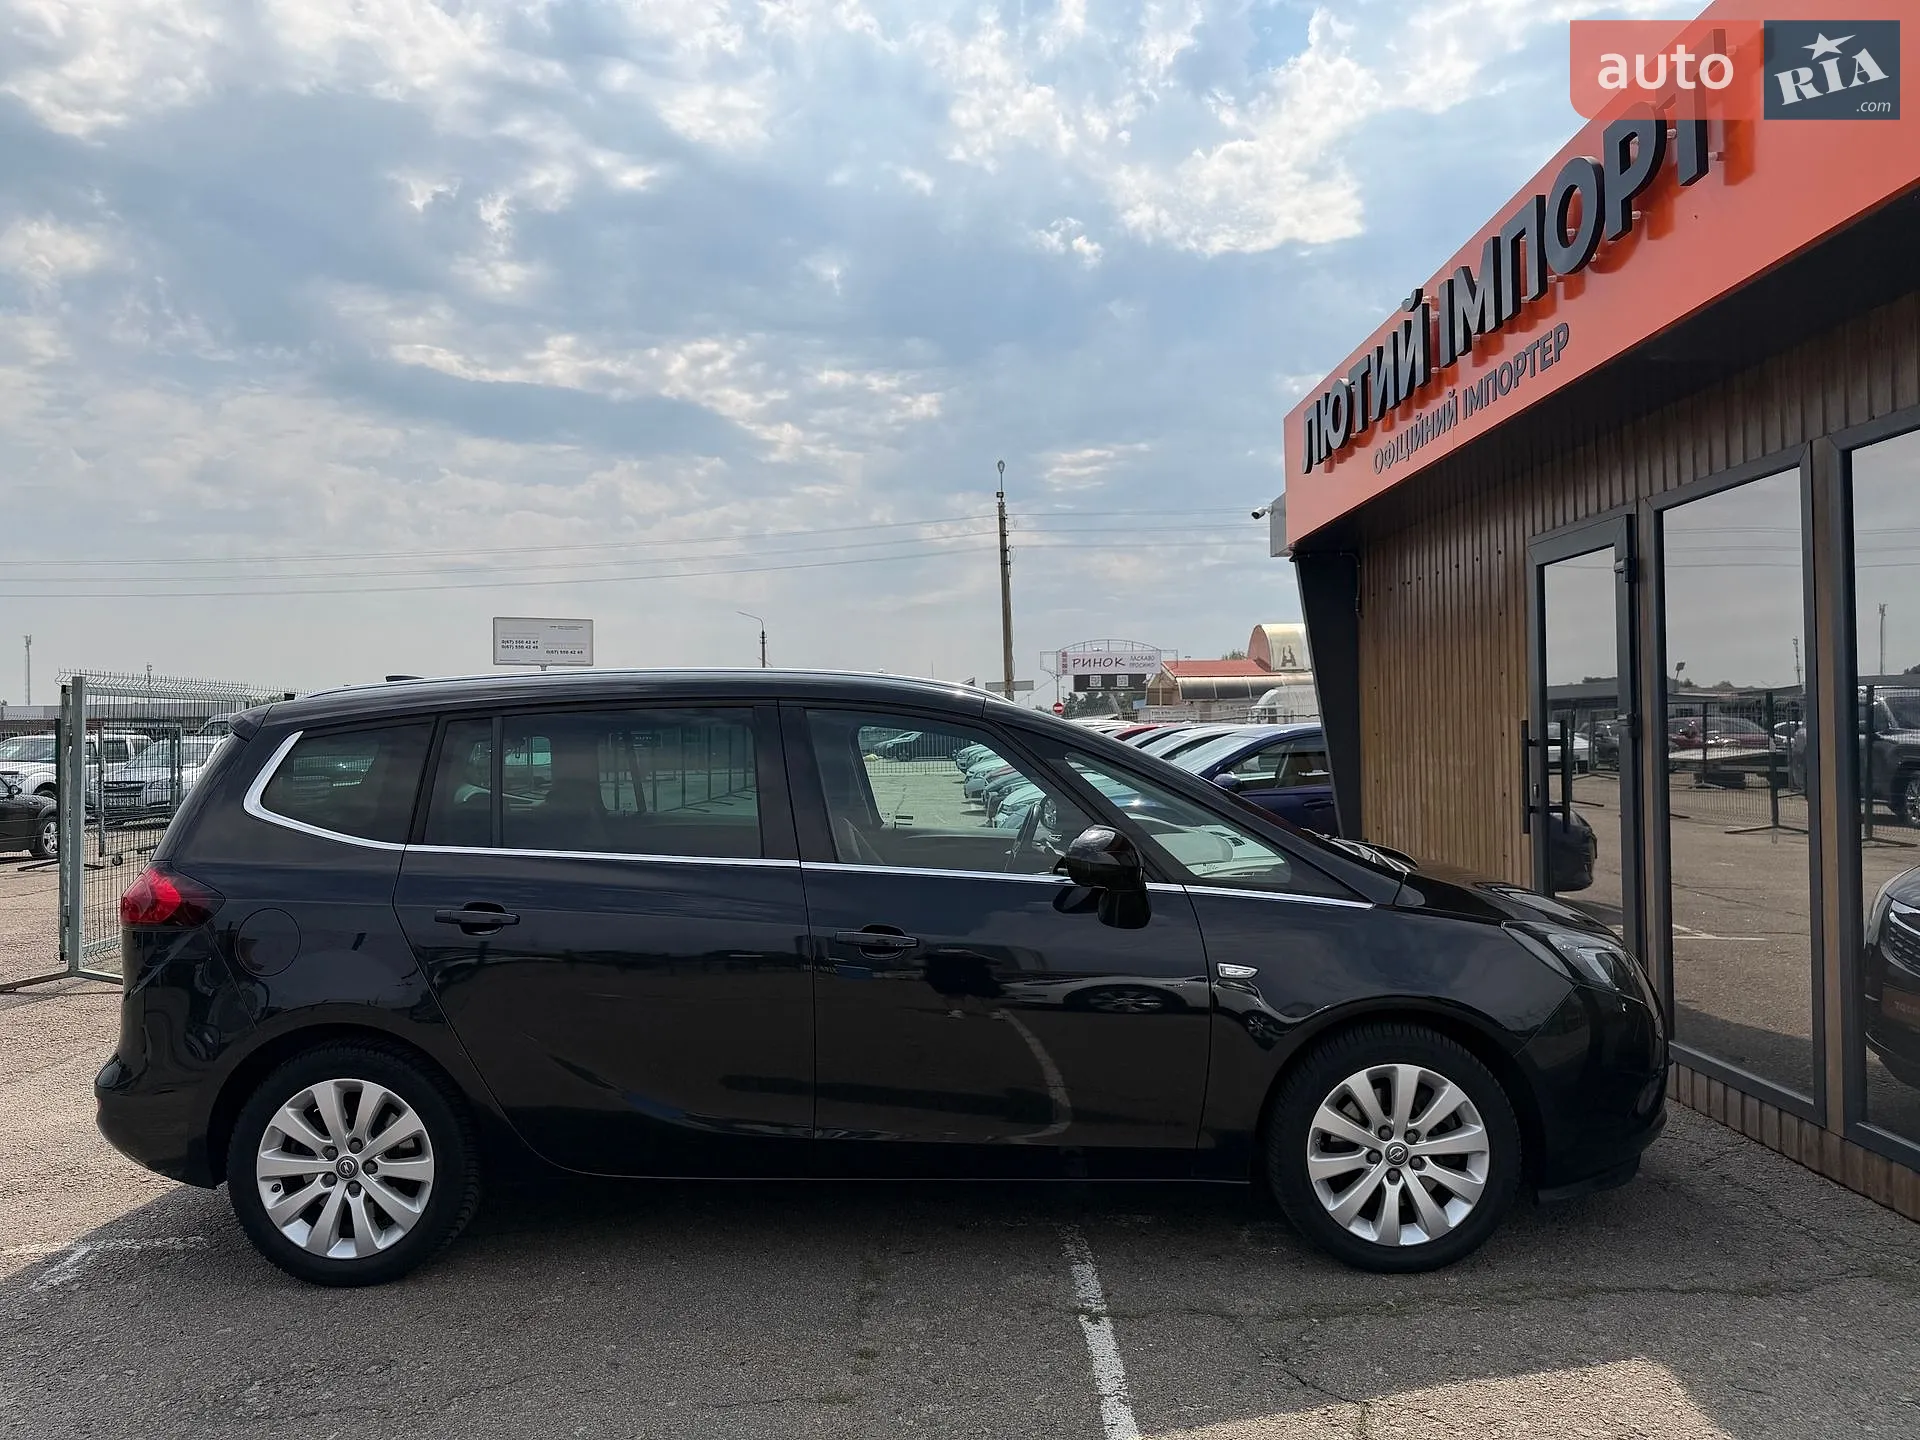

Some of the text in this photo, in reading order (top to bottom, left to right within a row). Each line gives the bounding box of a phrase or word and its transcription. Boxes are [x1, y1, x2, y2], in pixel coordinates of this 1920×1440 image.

[1302, 28, 1726, 474] ЛЮТИЙ ІМПОРТ
[1373, 322, 1570, 475] ОФІЦІЙНИЙ ІМПОРТЕР
[1071, 656, 1125, 668] РИНОК
